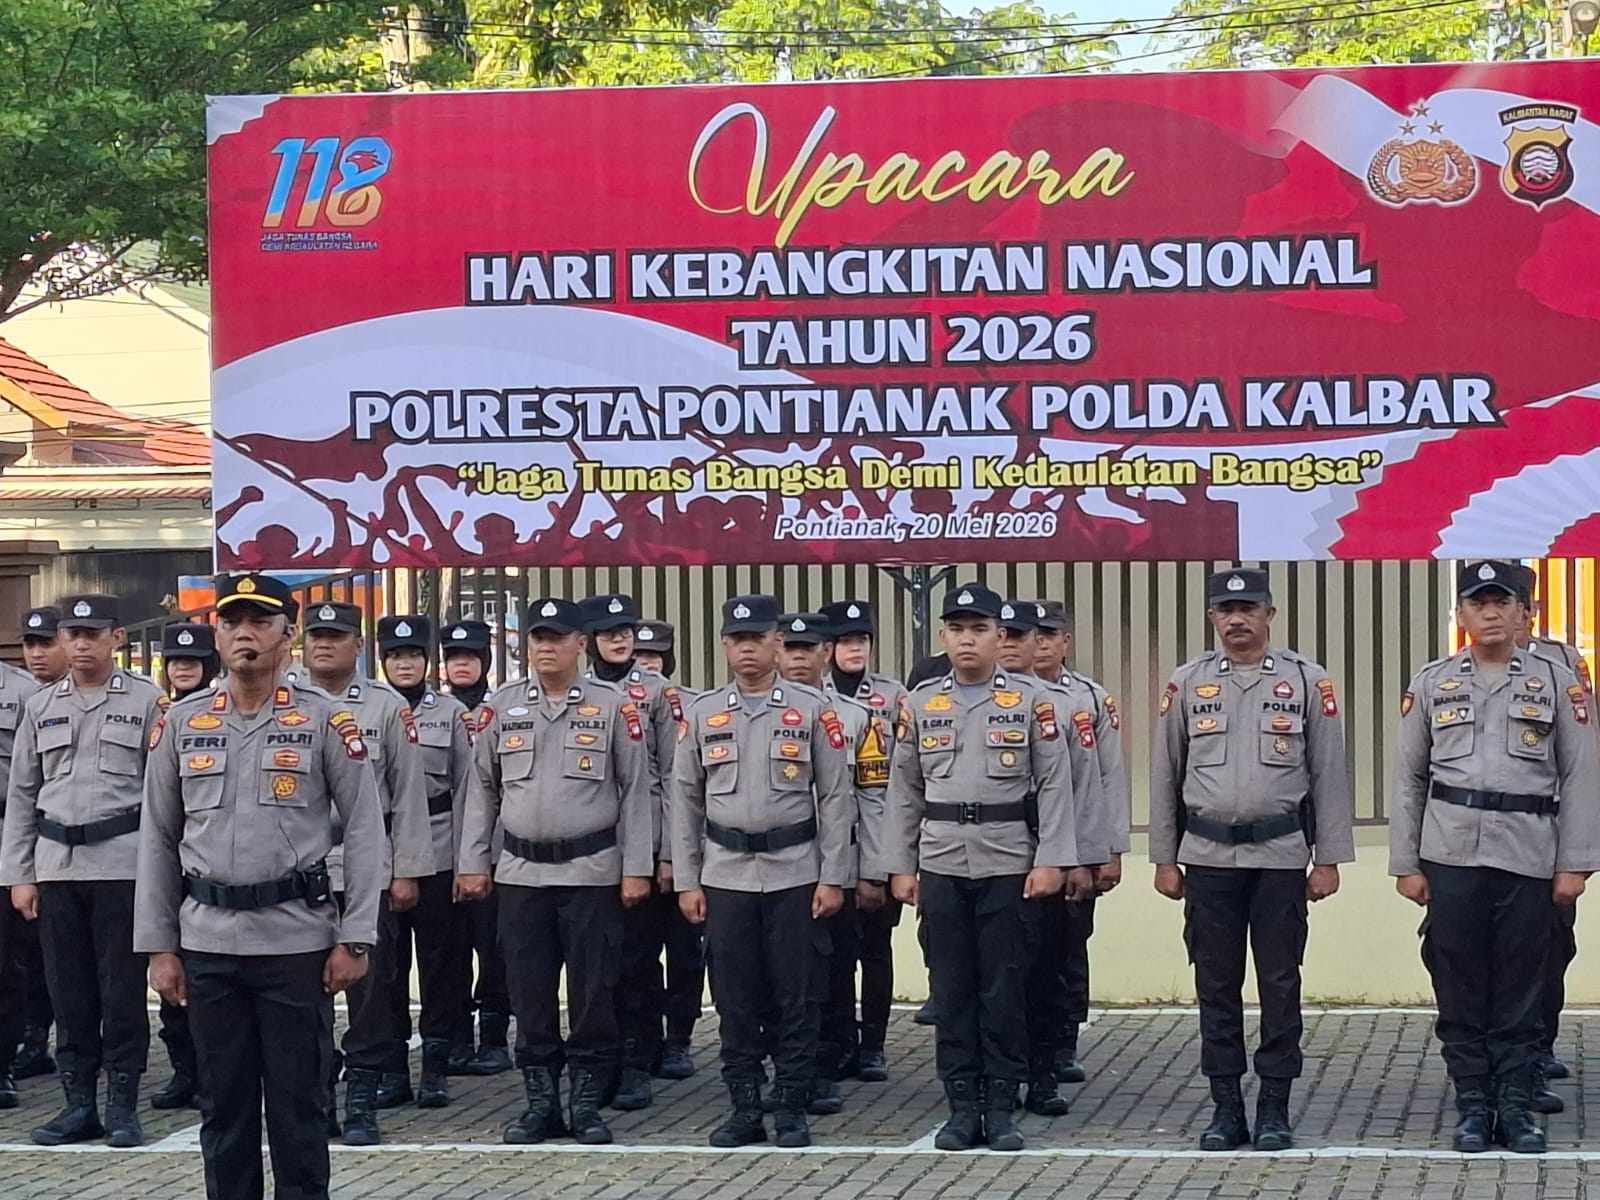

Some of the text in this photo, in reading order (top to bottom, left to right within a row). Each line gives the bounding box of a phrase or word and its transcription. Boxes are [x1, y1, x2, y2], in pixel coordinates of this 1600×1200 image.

[261, 136, 392, 228] 118
[687, 101, 1136, 249] Upacara
[468, 238, 1373, 302] HARI KEBANGKITAN NASIONAL
[730, 314, 1093, 366] TAHUN 2026
[354, 377, 1499, 441] POLRESTA PONTIANAK POLDA KALBAR
[457, 450, 1382, 501] “Jaga Tunas Bangsa Demi Kedaulatan Bangsa”
[775, 512, 1056, 541] Pontianak, 20 Mei 2026
[1512, 693, 1552, 706] POLRI
[1192, 702, 1223, 715] LATU
[1262, 701, 1301, 715] POLRI
[105, 713, 143, 726] POLRI
[419, 720, 451, 730] POLRI
[569, 719, 606, 730] POLRI
[988, 713, 1026, 725] POLRI
[266, 733, 313, 746] POLRI
[773, 729, 810, 741] POLRI
[182, 736, 228, 750] FERI
